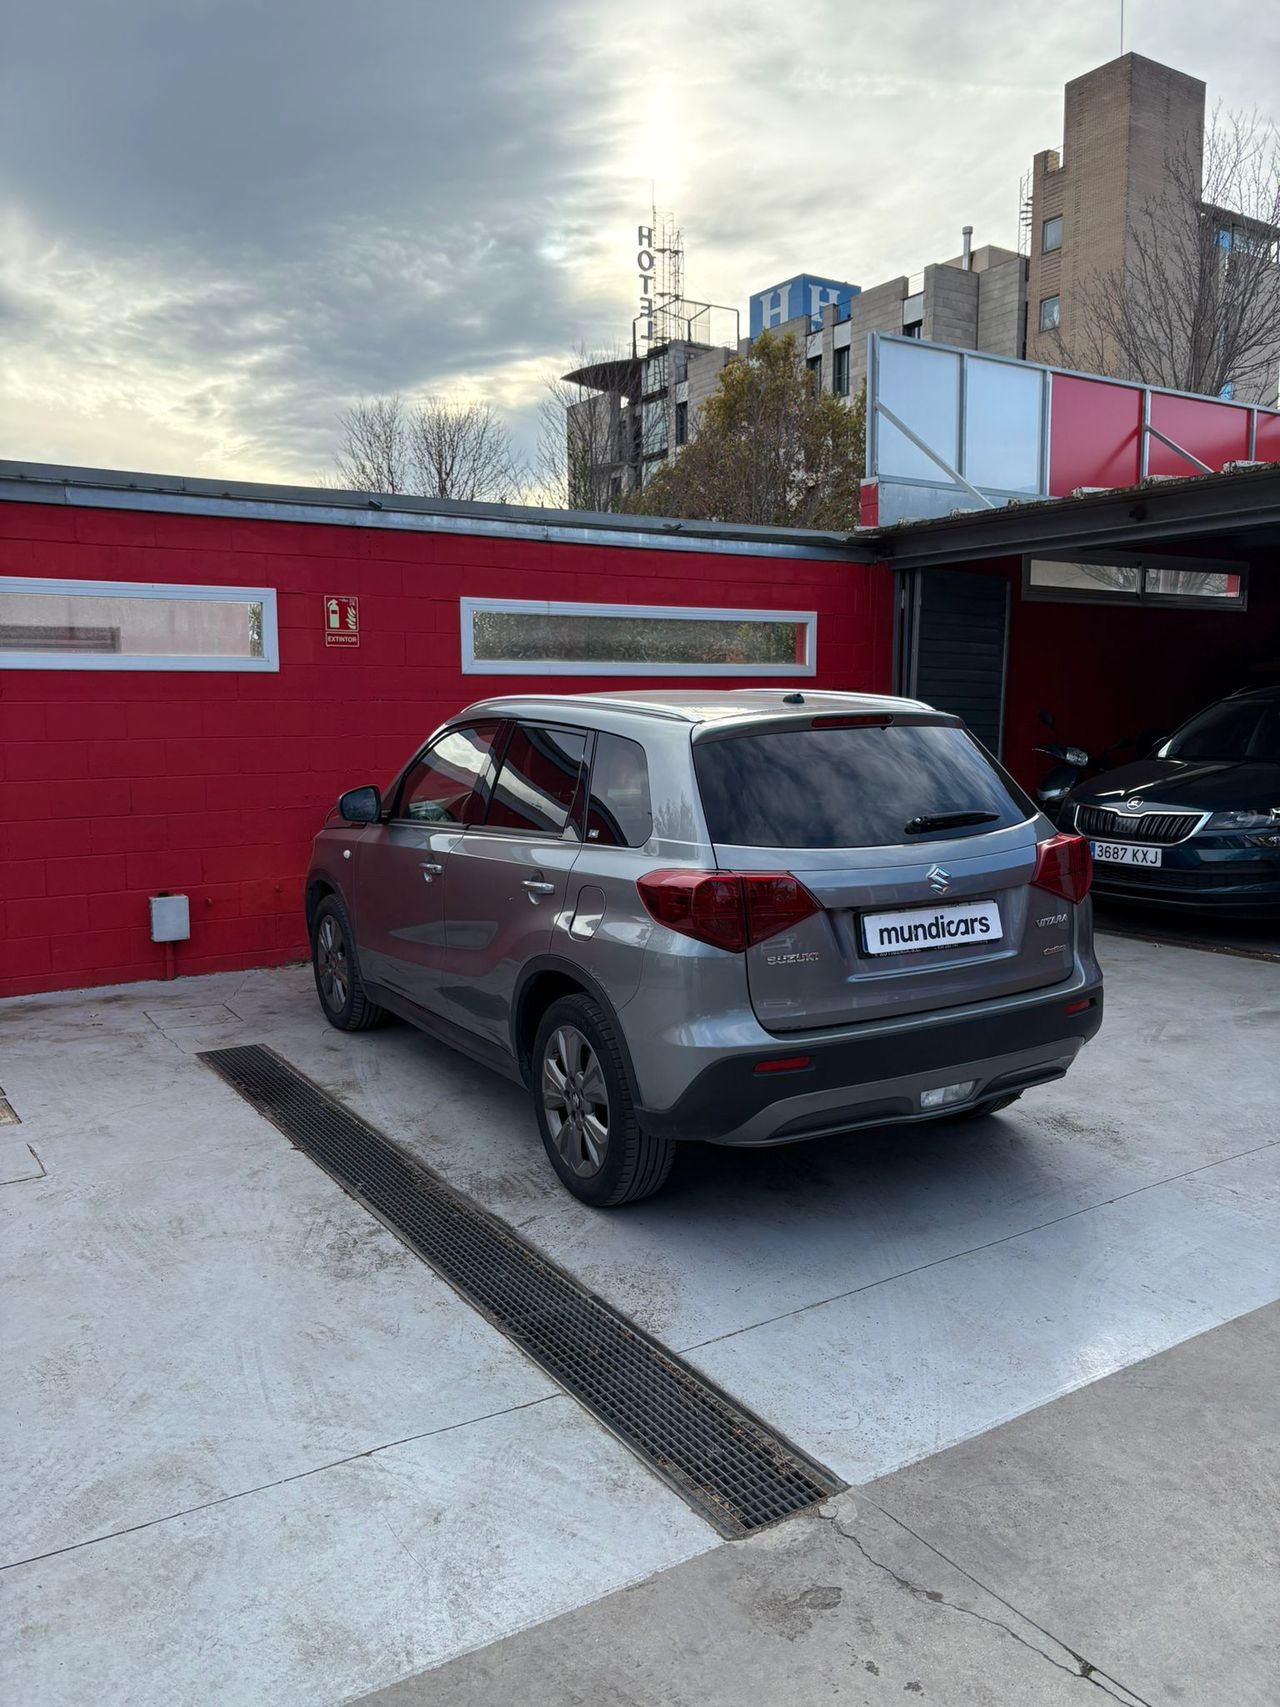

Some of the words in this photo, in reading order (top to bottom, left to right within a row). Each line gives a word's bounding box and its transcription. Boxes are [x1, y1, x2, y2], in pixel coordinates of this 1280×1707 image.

[760, 284, 792, 329] H
[327, 635, 357, 643] EXTINTOR
[1097, 844, 1128, 861] 3687
[1131, 848, 1159, 865] KXJ
[1035, 913, 1068, 928] VITARA
[878, 914, 991, 946] mundicars
[767, 951, 819, 966] SUZUKI
